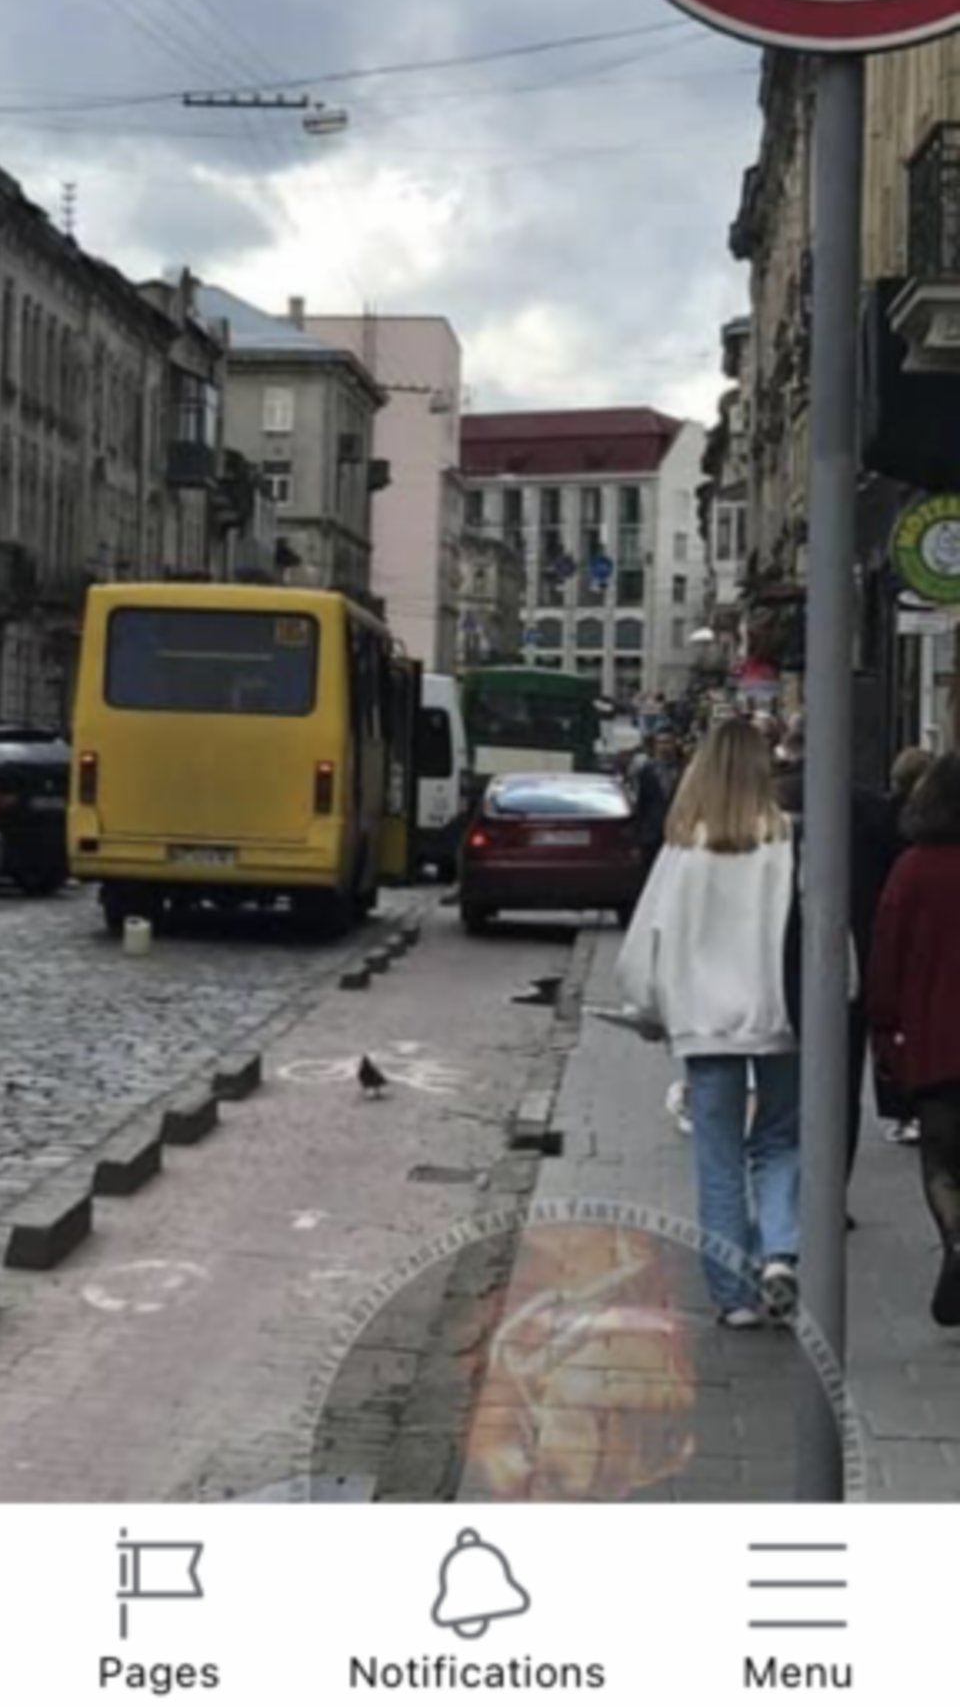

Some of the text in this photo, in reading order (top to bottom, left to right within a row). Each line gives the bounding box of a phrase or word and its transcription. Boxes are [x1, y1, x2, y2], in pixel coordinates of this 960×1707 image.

[98, 1655, 221, 1697] Pages
[348, 1654, 606, 1690] Notifications
[743, 1655, 853, 1690] Menu
